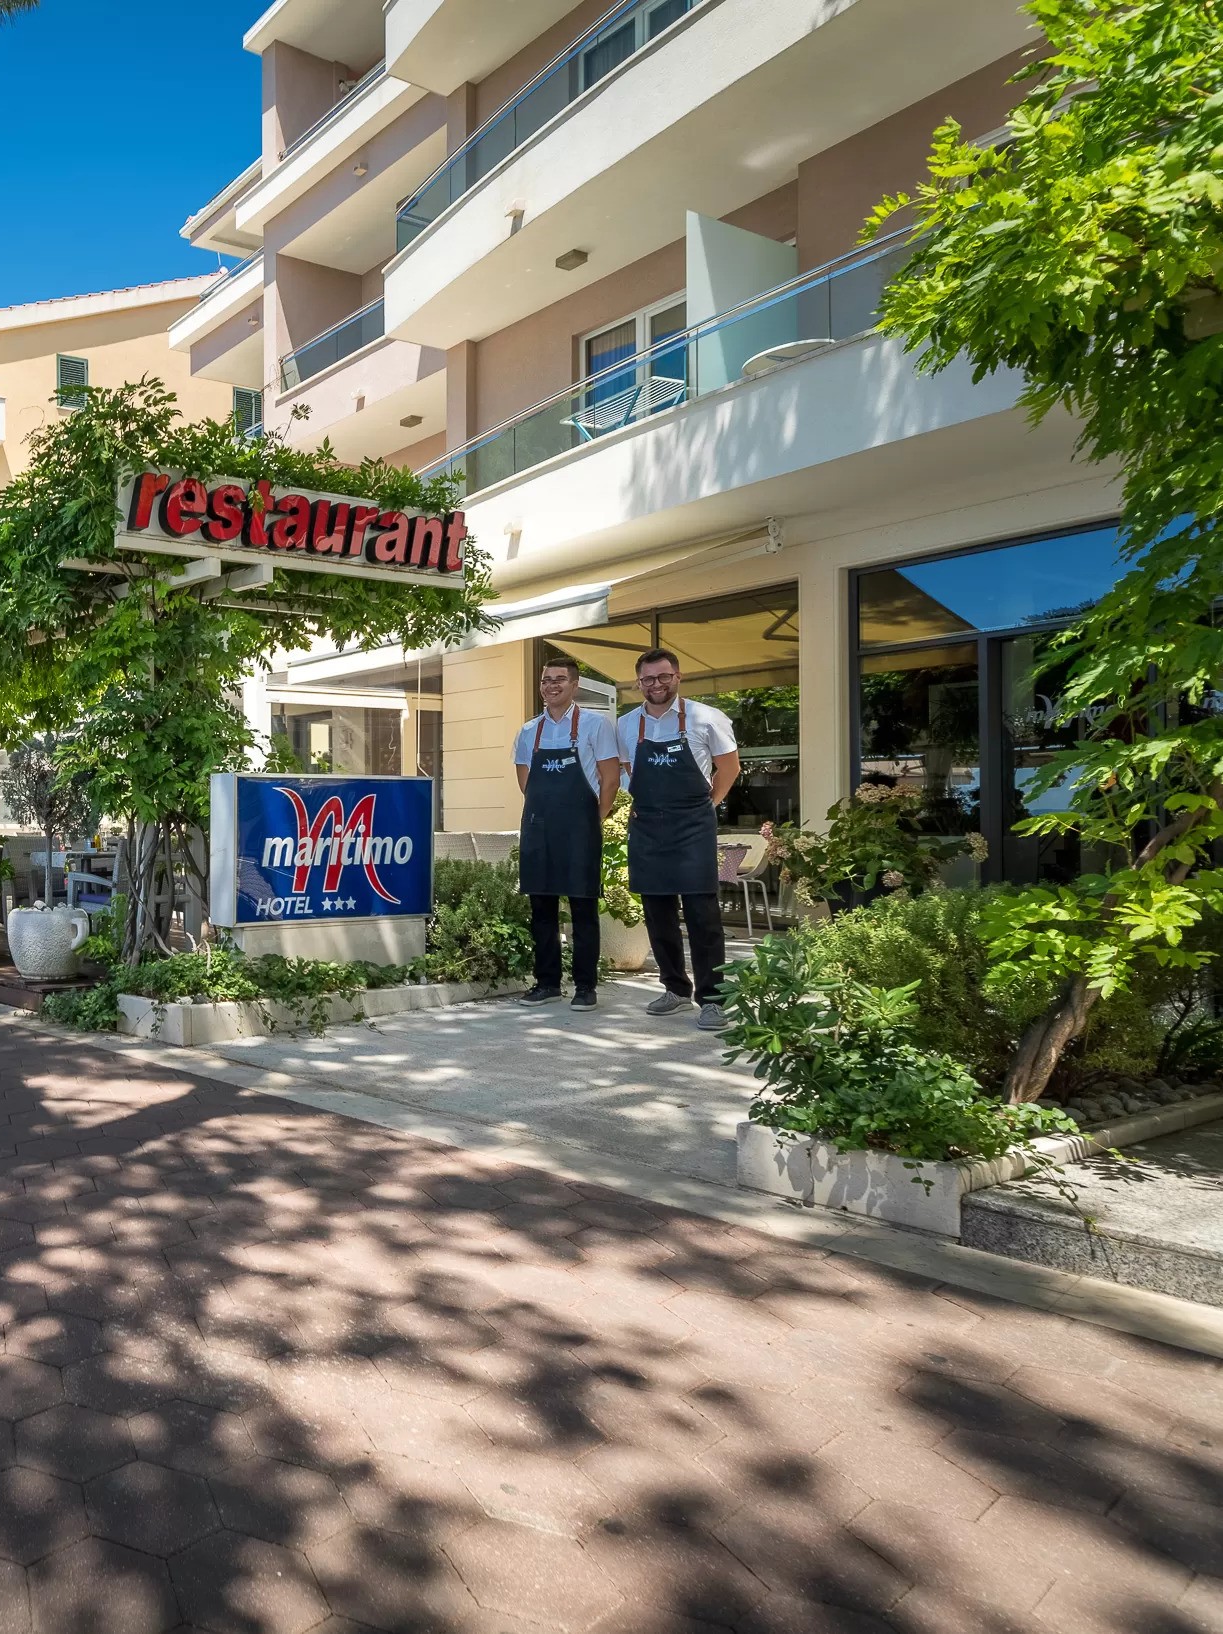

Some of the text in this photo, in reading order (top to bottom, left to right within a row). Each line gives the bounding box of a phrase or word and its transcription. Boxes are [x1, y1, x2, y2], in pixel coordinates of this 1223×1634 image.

[128, 472, 468, 574] restaurant
[262, 824, 413, 868] maritimo
[255, 896, 314, 916] HOTEL
